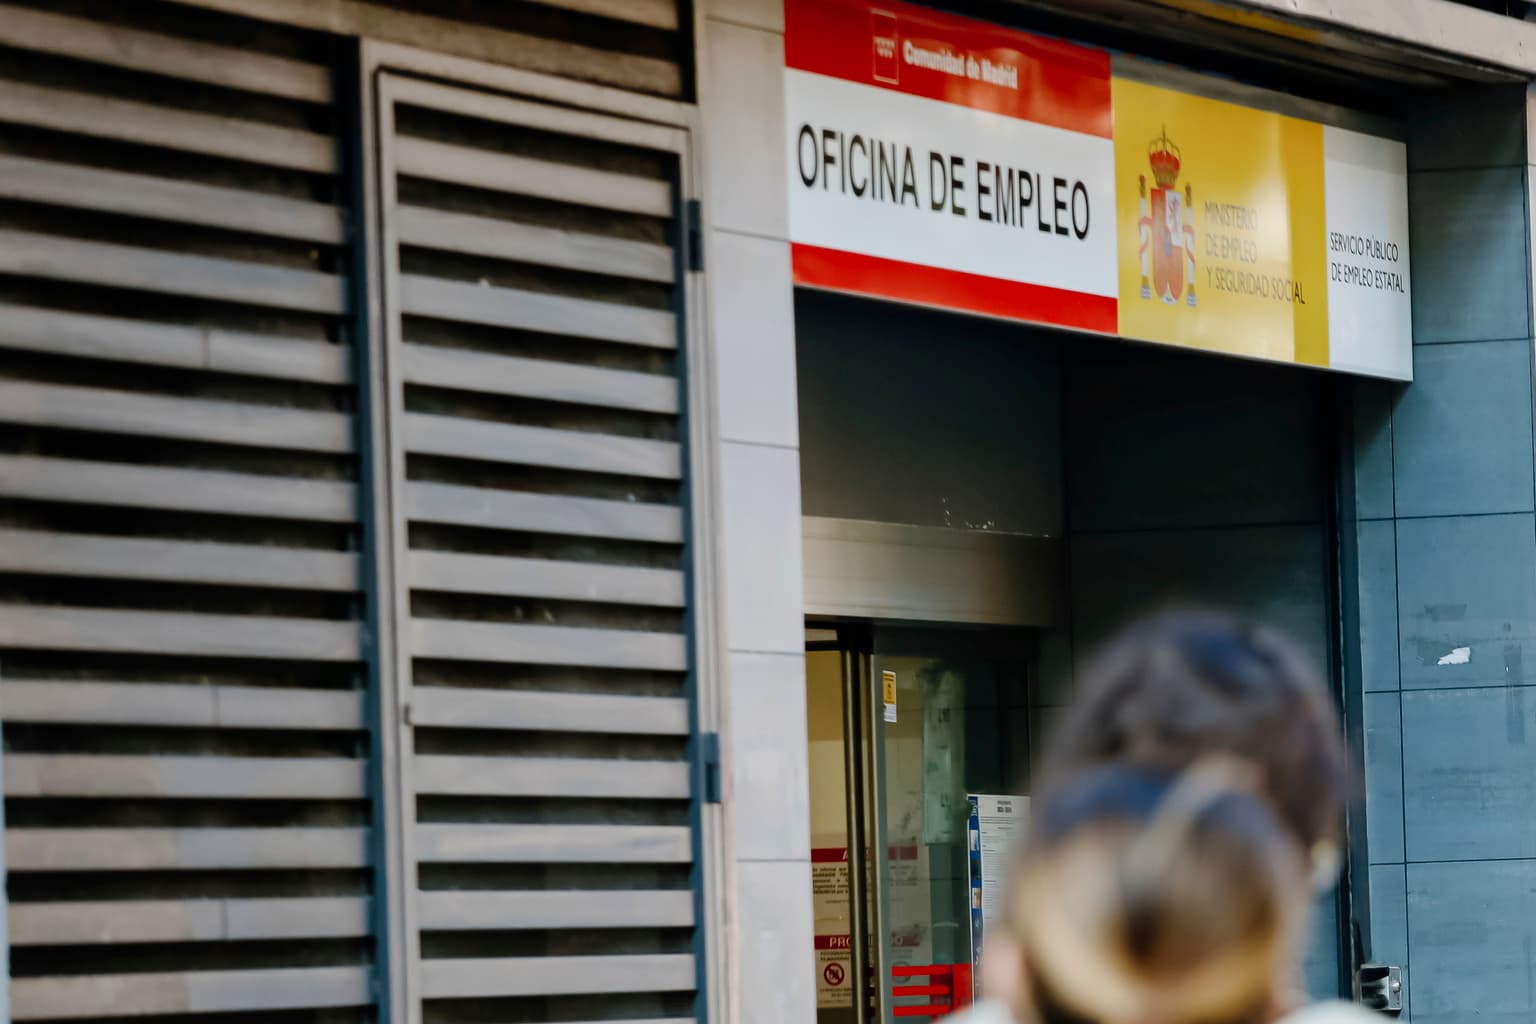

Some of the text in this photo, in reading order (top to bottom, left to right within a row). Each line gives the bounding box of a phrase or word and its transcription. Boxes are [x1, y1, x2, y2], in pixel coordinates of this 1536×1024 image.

[798, 123, 1090, 241] OFICINA DE EMPLEO
[1204, 200, 1258, 231] MINISTERIO
[1205, 233, 1258, 265] DE EMPLEO
[1330, 231, 1399, 263] SERVICIO PÚBLICO
[1206, 265, 1306, 305] Y SEGURIDAD SOCIAL
[1331, 261, 1405, 294] DE EMPLEO ESTATAL
